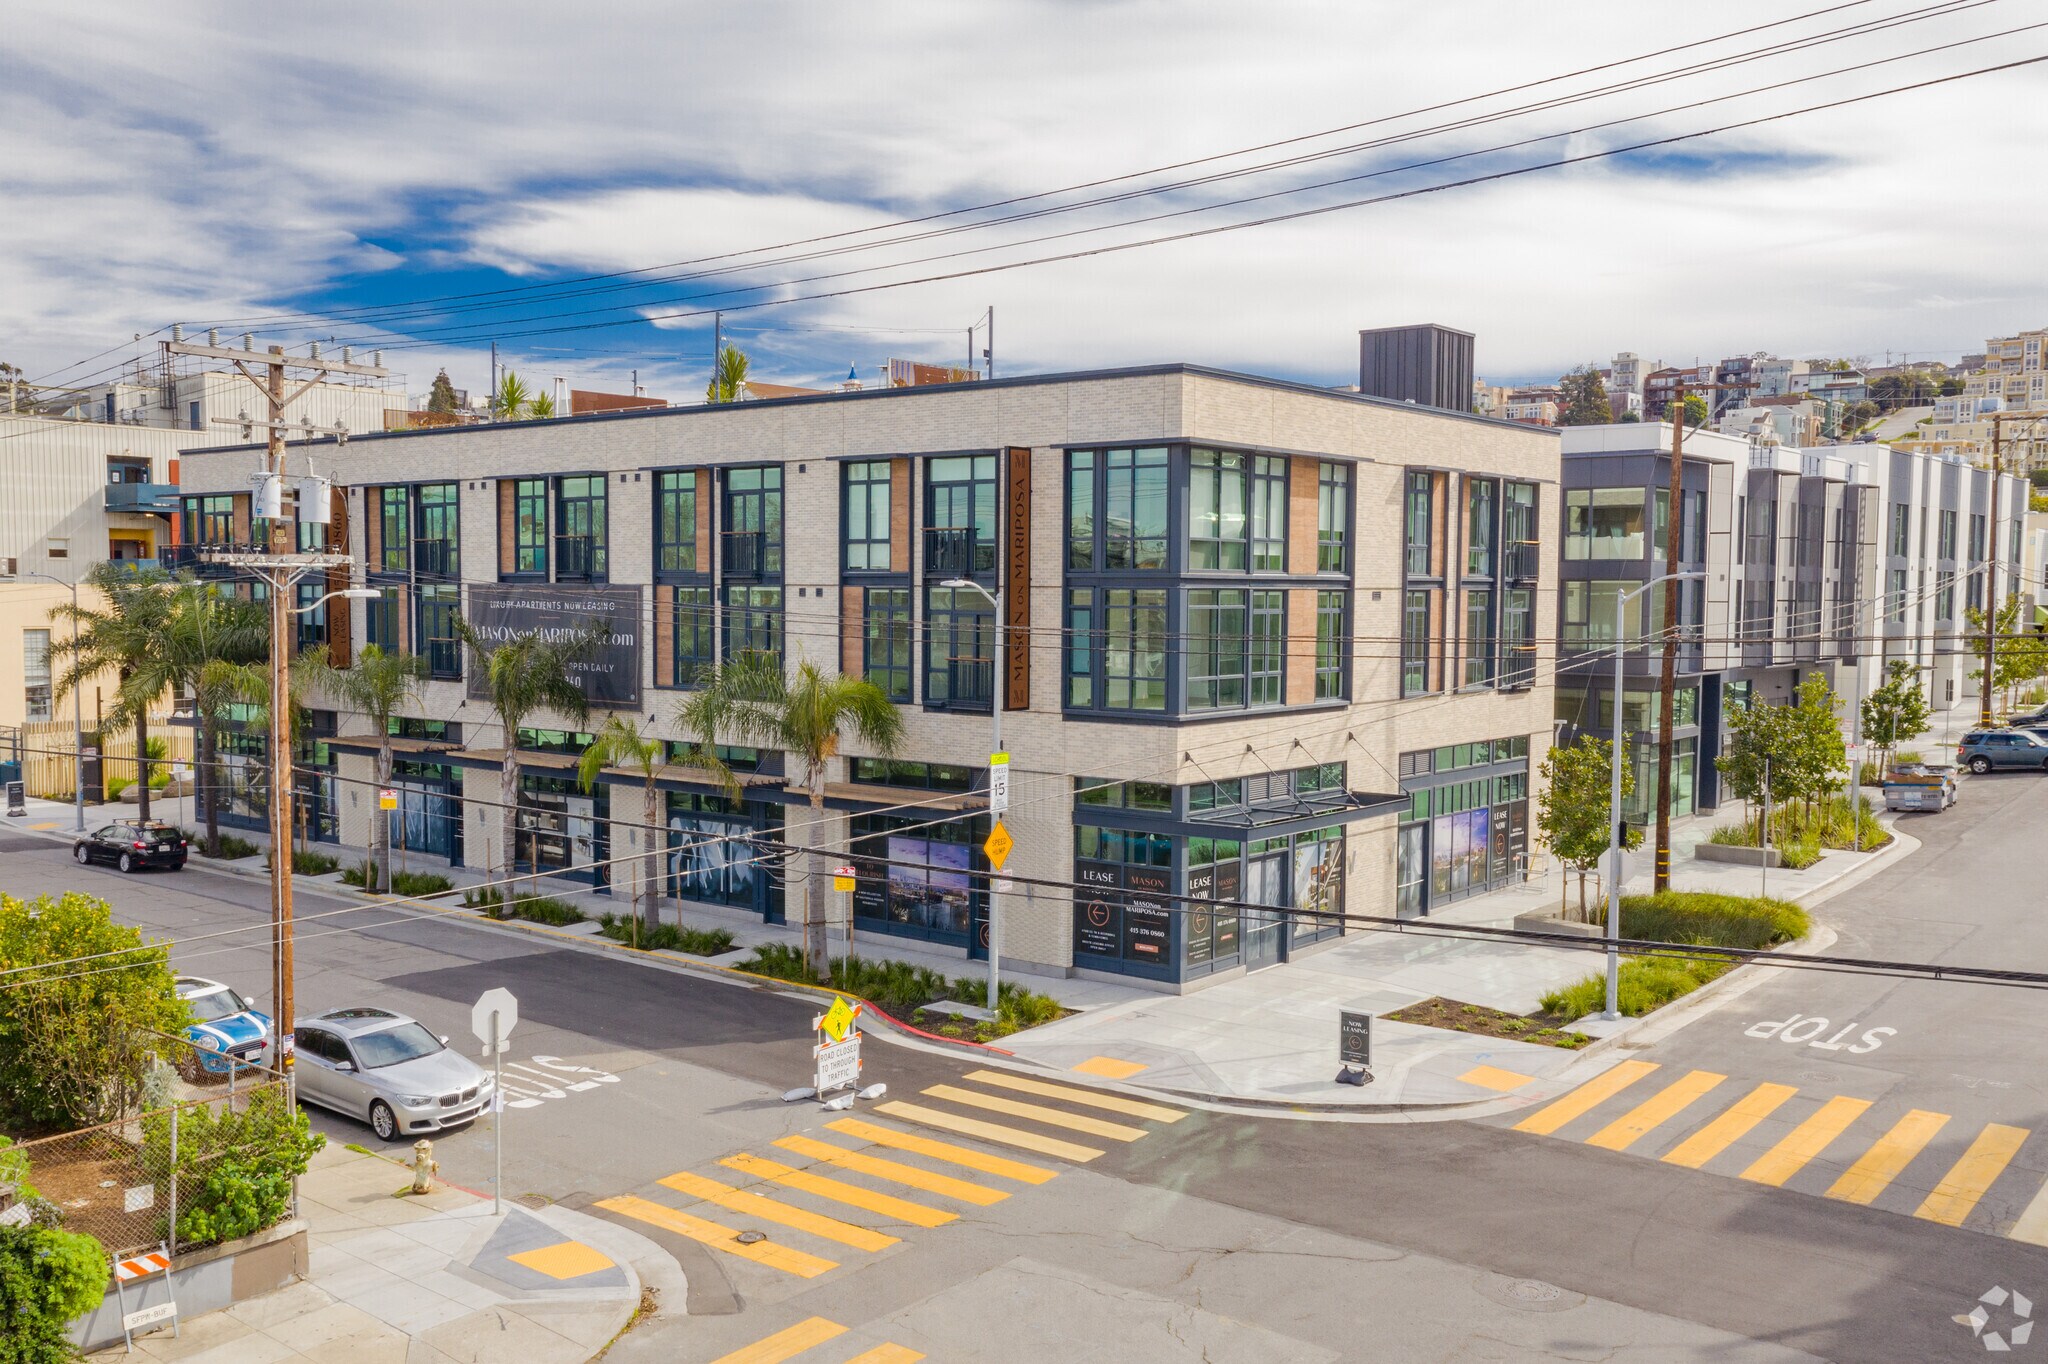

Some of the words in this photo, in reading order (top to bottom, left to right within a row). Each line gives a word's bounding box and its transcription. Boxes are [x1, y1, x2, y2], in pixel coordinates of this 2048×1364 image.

[1014, 478, 1025, 579] MARIPOSA
[1016, 585, 1024, 605] ON
[515, 601, 561, 610] APARTMENTS
[564, 602, 581, 610] NOW
[582, 602, 615, 611] LEASING
[1014, 611, 1024, 681] MASON
[590, 663, 614, 672] DAILY
[993, 774, 1006, 782] LIMIT
[994, 782, 1005, 797] 15
[991, 838, 1006, 846] SPEED
[1083, 870, 1114, 883] LEASE
[1131, 876, 1165, 888] MASON
[1190, 876, 1211, 889] LEASE
[1126, 906, 1169, 918] MARIPOSA.com
[1343, 1025, 1369, 1035] LEASING
[1348, 1020, 1362, 1028] NOW
[1743, 1013, 1899, 1054] STOP
[820, 1051, 835, 1063] ROAD
[836, 1043, 858, 1057] CLOSED
[822, 1064, 829, 1073] TO
[830, 1055, 856, 1071] THROUGH
[828, 1068, 850, 1081] TRAFFIC
